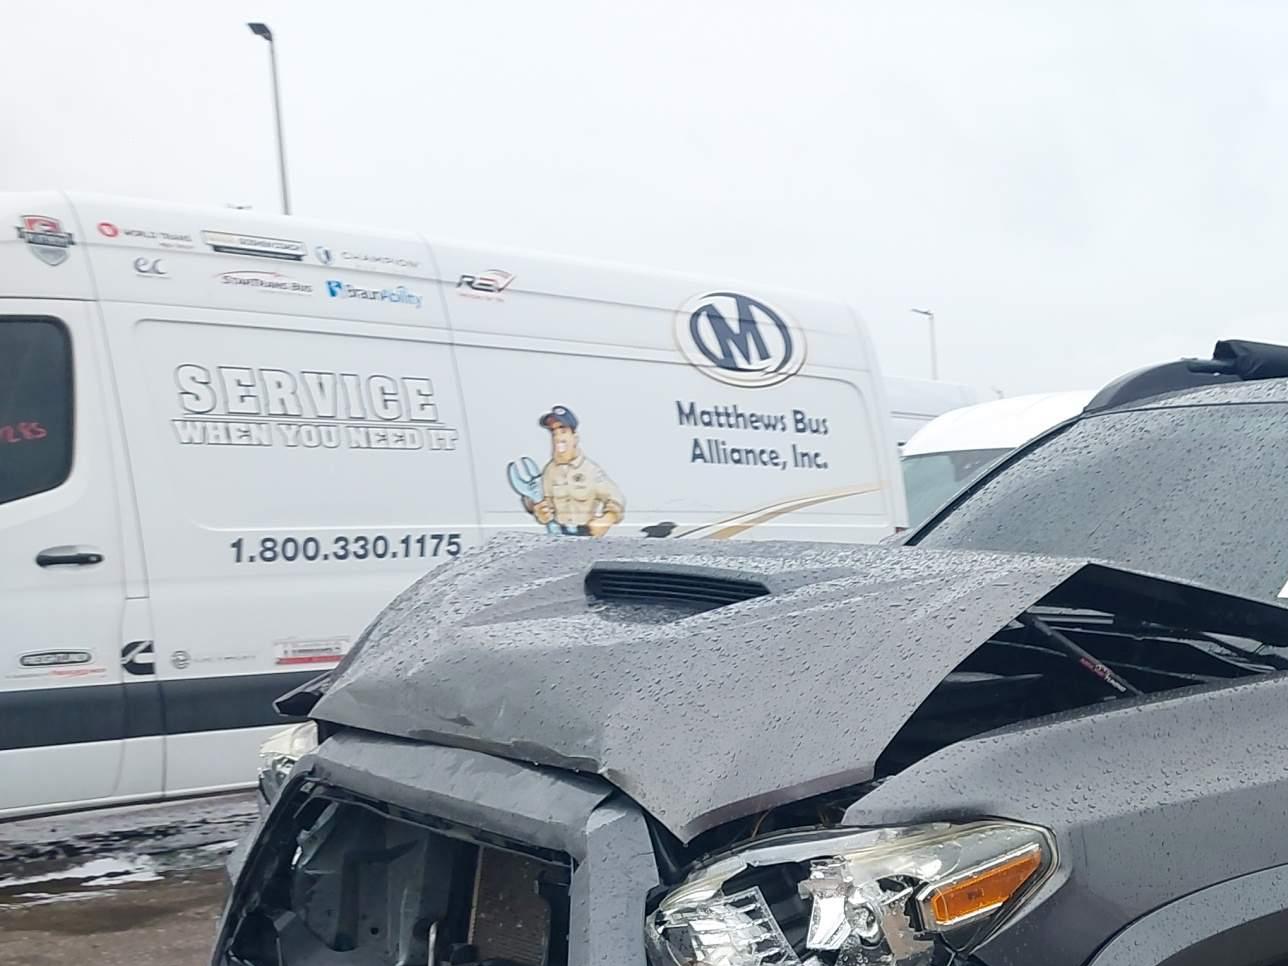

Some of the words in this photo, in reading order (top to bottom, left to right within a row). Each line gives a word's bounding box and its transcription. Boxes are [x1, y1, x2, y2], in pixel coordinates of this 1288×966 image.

[174, 364, 440, 421] SERVICE
[171, 418, 273, 447] WHEN
[276, 422, 341, 449] YOU
[345, 425, 423, 450] NEED
[426, 427, 459, 451] IT
[676, 400, 787, 432] Matthews
[792, 409, 829, 435] Bus
[691, 437, 788, 471] Alliance,
[792, 443, 829, 470] Inc.
[230, 533, 462, 563] 1.800.330.1175
